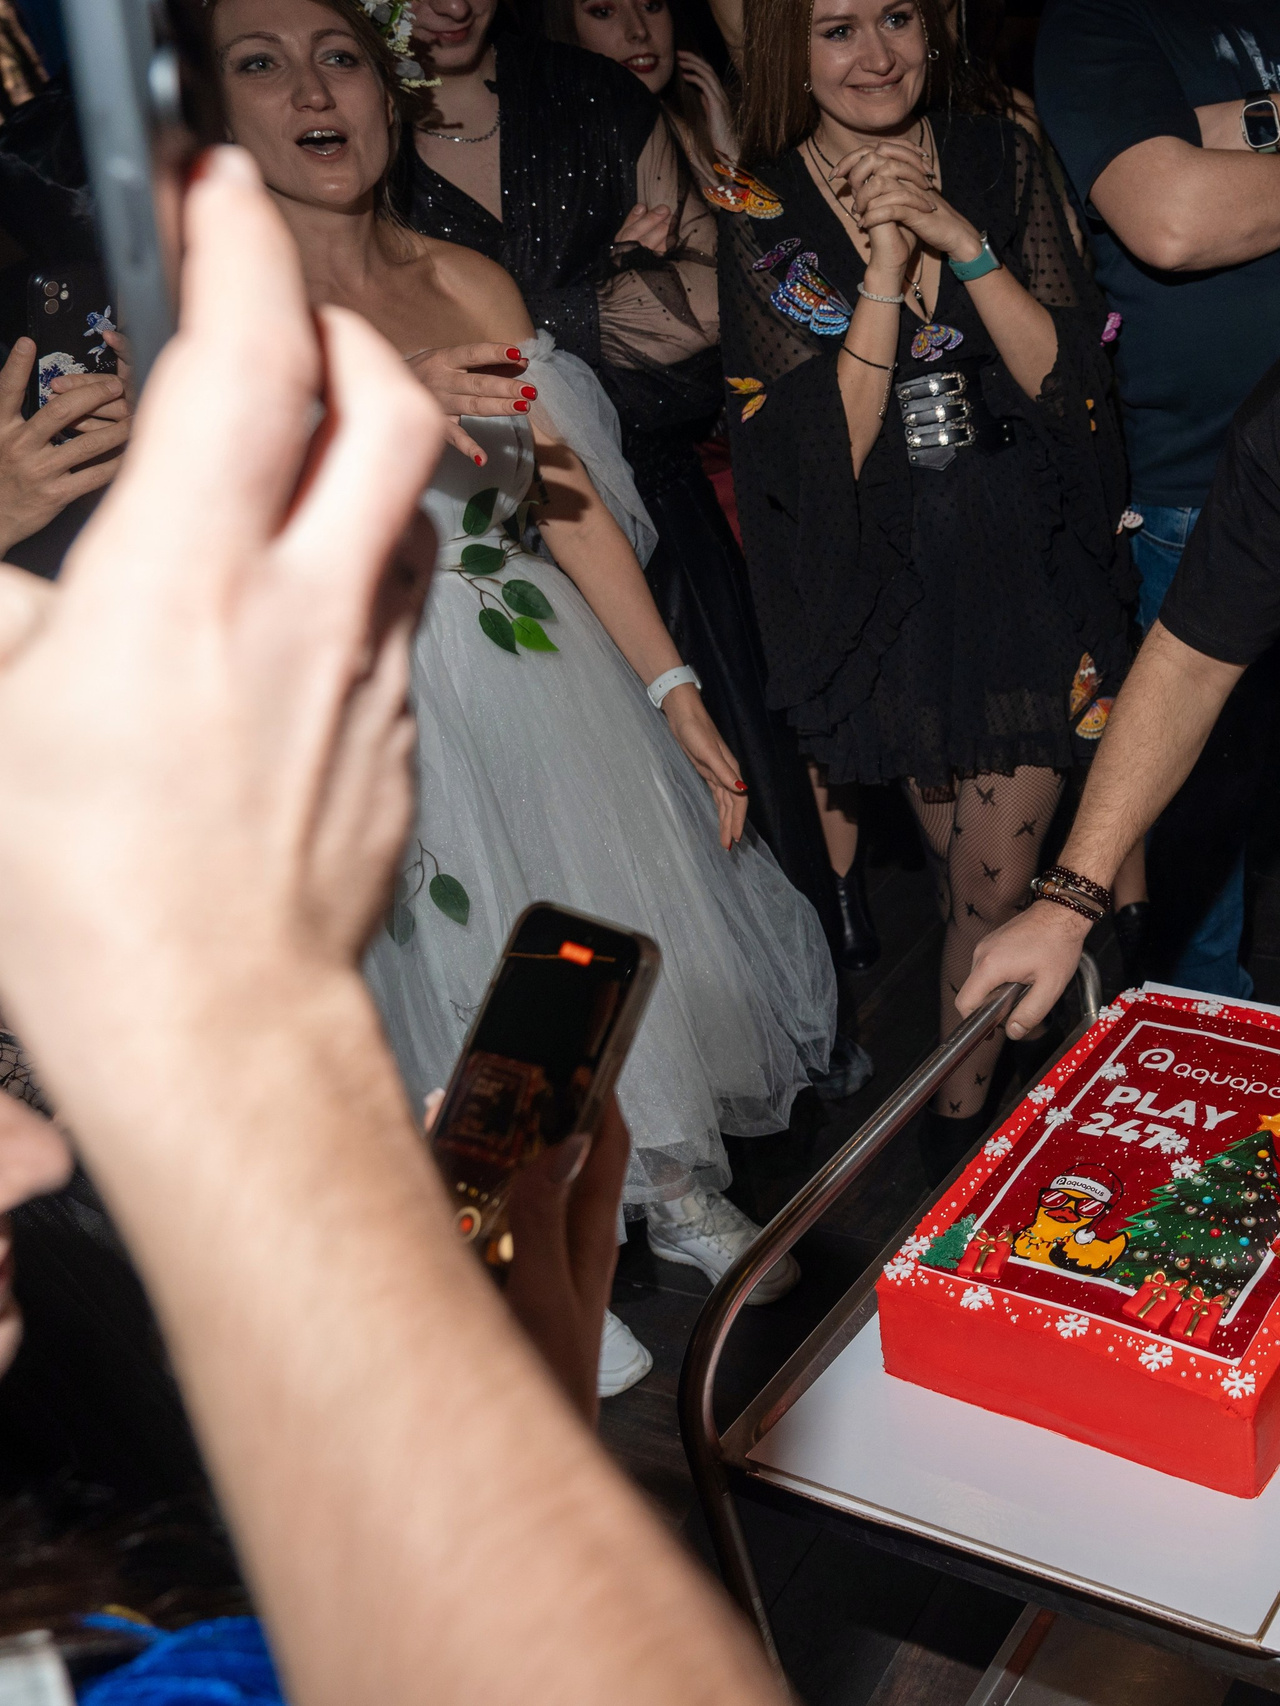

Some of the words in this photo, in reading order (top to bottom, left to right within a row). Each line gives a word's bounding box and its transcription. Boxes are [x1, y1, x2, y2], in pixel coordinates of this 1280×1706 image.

[1101, 1085, 1239, 1130] PLAY
[1077, 1112, 1177, 1149] 247
[1066, 1180, 1105, 1197] aquapolis
